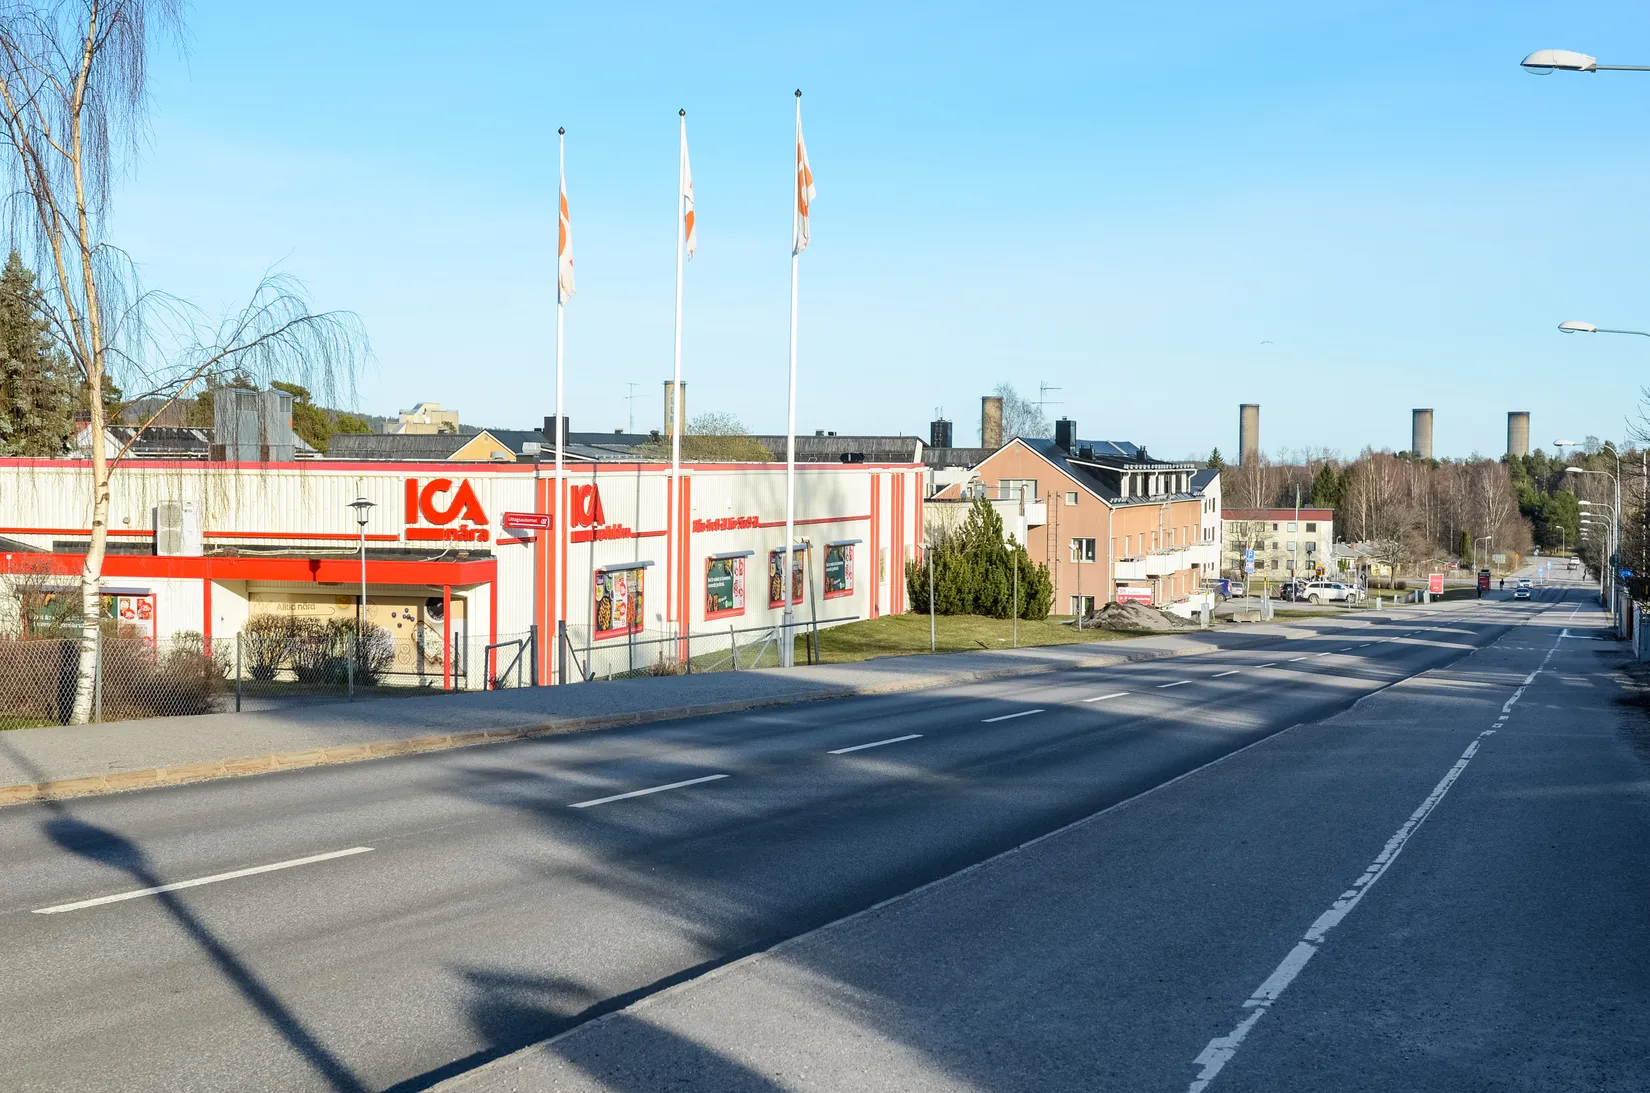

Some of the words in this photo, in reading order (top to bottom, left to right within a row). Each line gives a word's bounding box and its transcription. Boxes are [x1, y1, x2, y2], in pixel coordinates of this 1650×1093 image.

[405, 478, 489, 525] ICA
[570, 483, 606, 528] ICA
[508, 517, 538, 525] Uttagsautomat
[444, 524, 490, 542] nära
[277, 602, 296, 611] Alltid
[297, 602, 316, 610] nära
